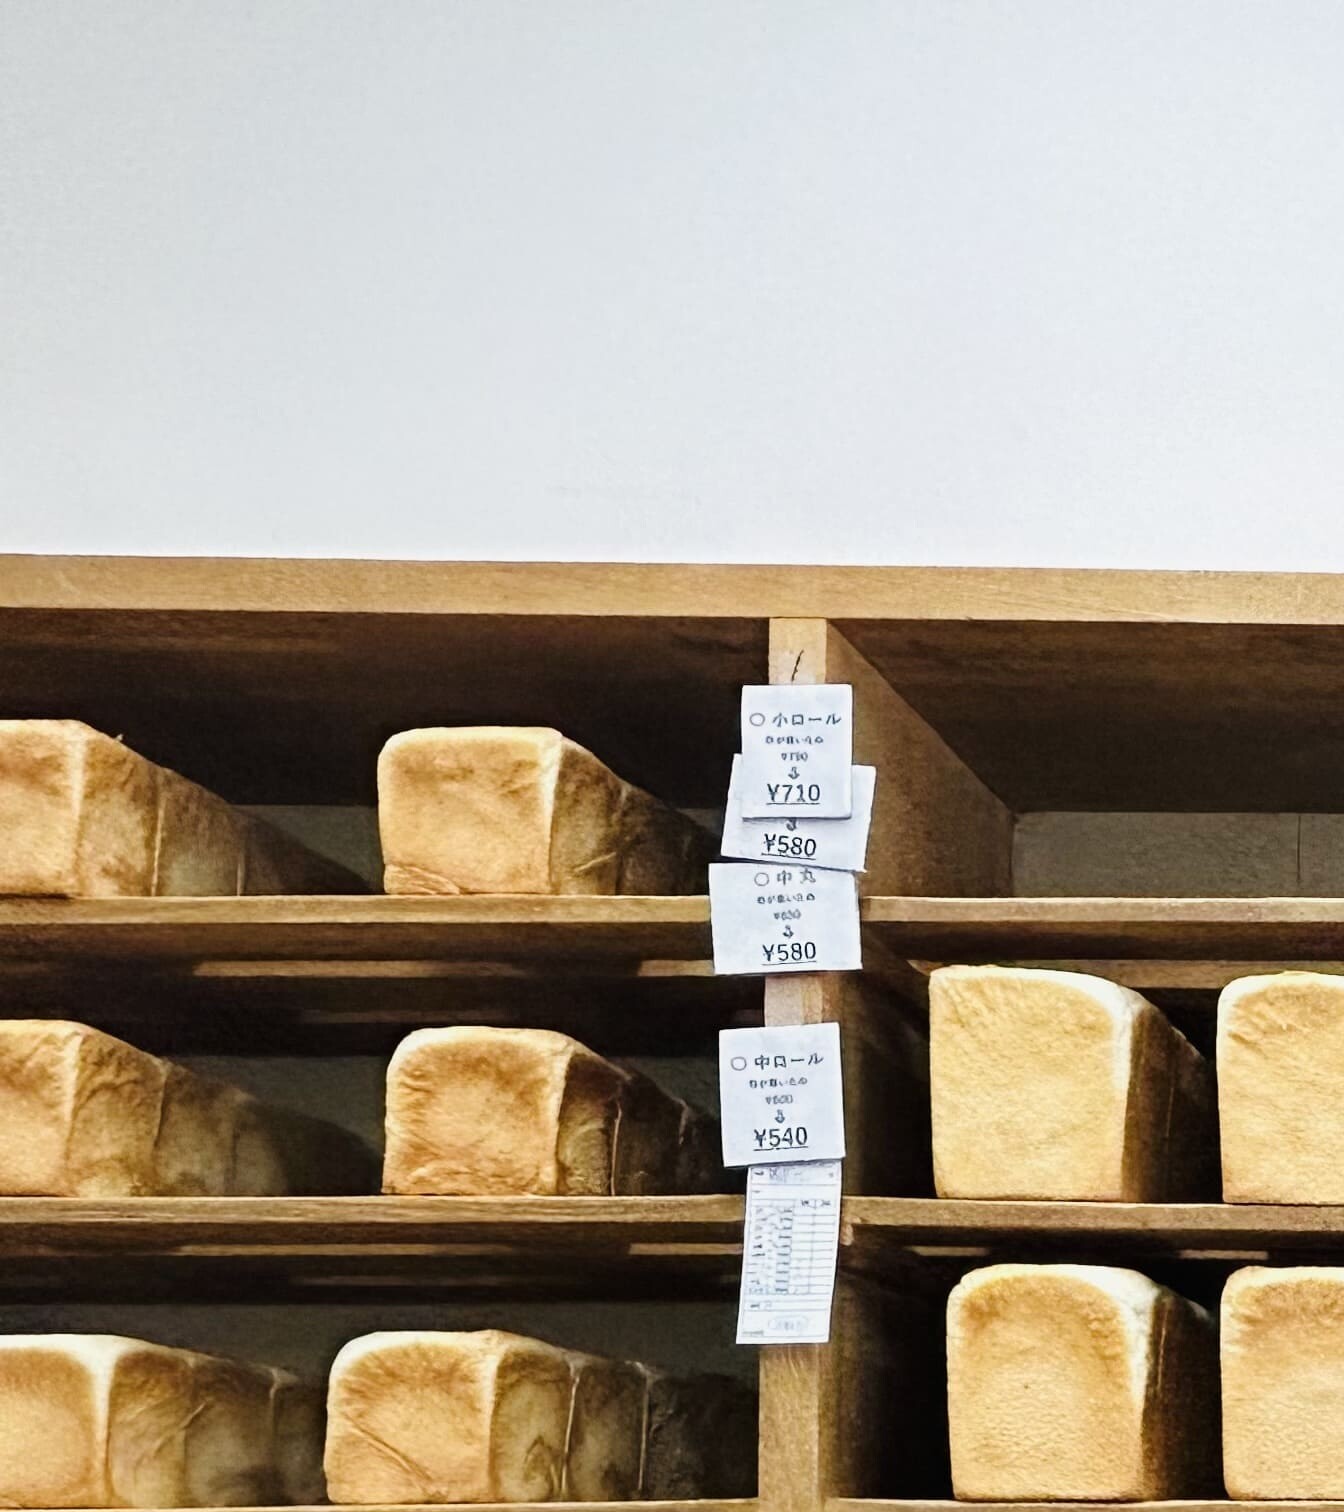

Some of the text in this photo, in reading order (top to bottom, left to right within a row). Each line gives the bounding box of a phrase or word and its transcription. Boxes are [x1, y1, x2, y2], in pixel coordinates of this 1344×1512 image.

[772, 712, 842, 728] 小ロール
[767, 783, 820, 802] ¥710
[763, 833, 817, 857] ¥580
[762, 941, 816, 962] ¥580
[754, 1053, 824, 1071] 中ロール
[753, 1126, 807, 1149] ¥540
